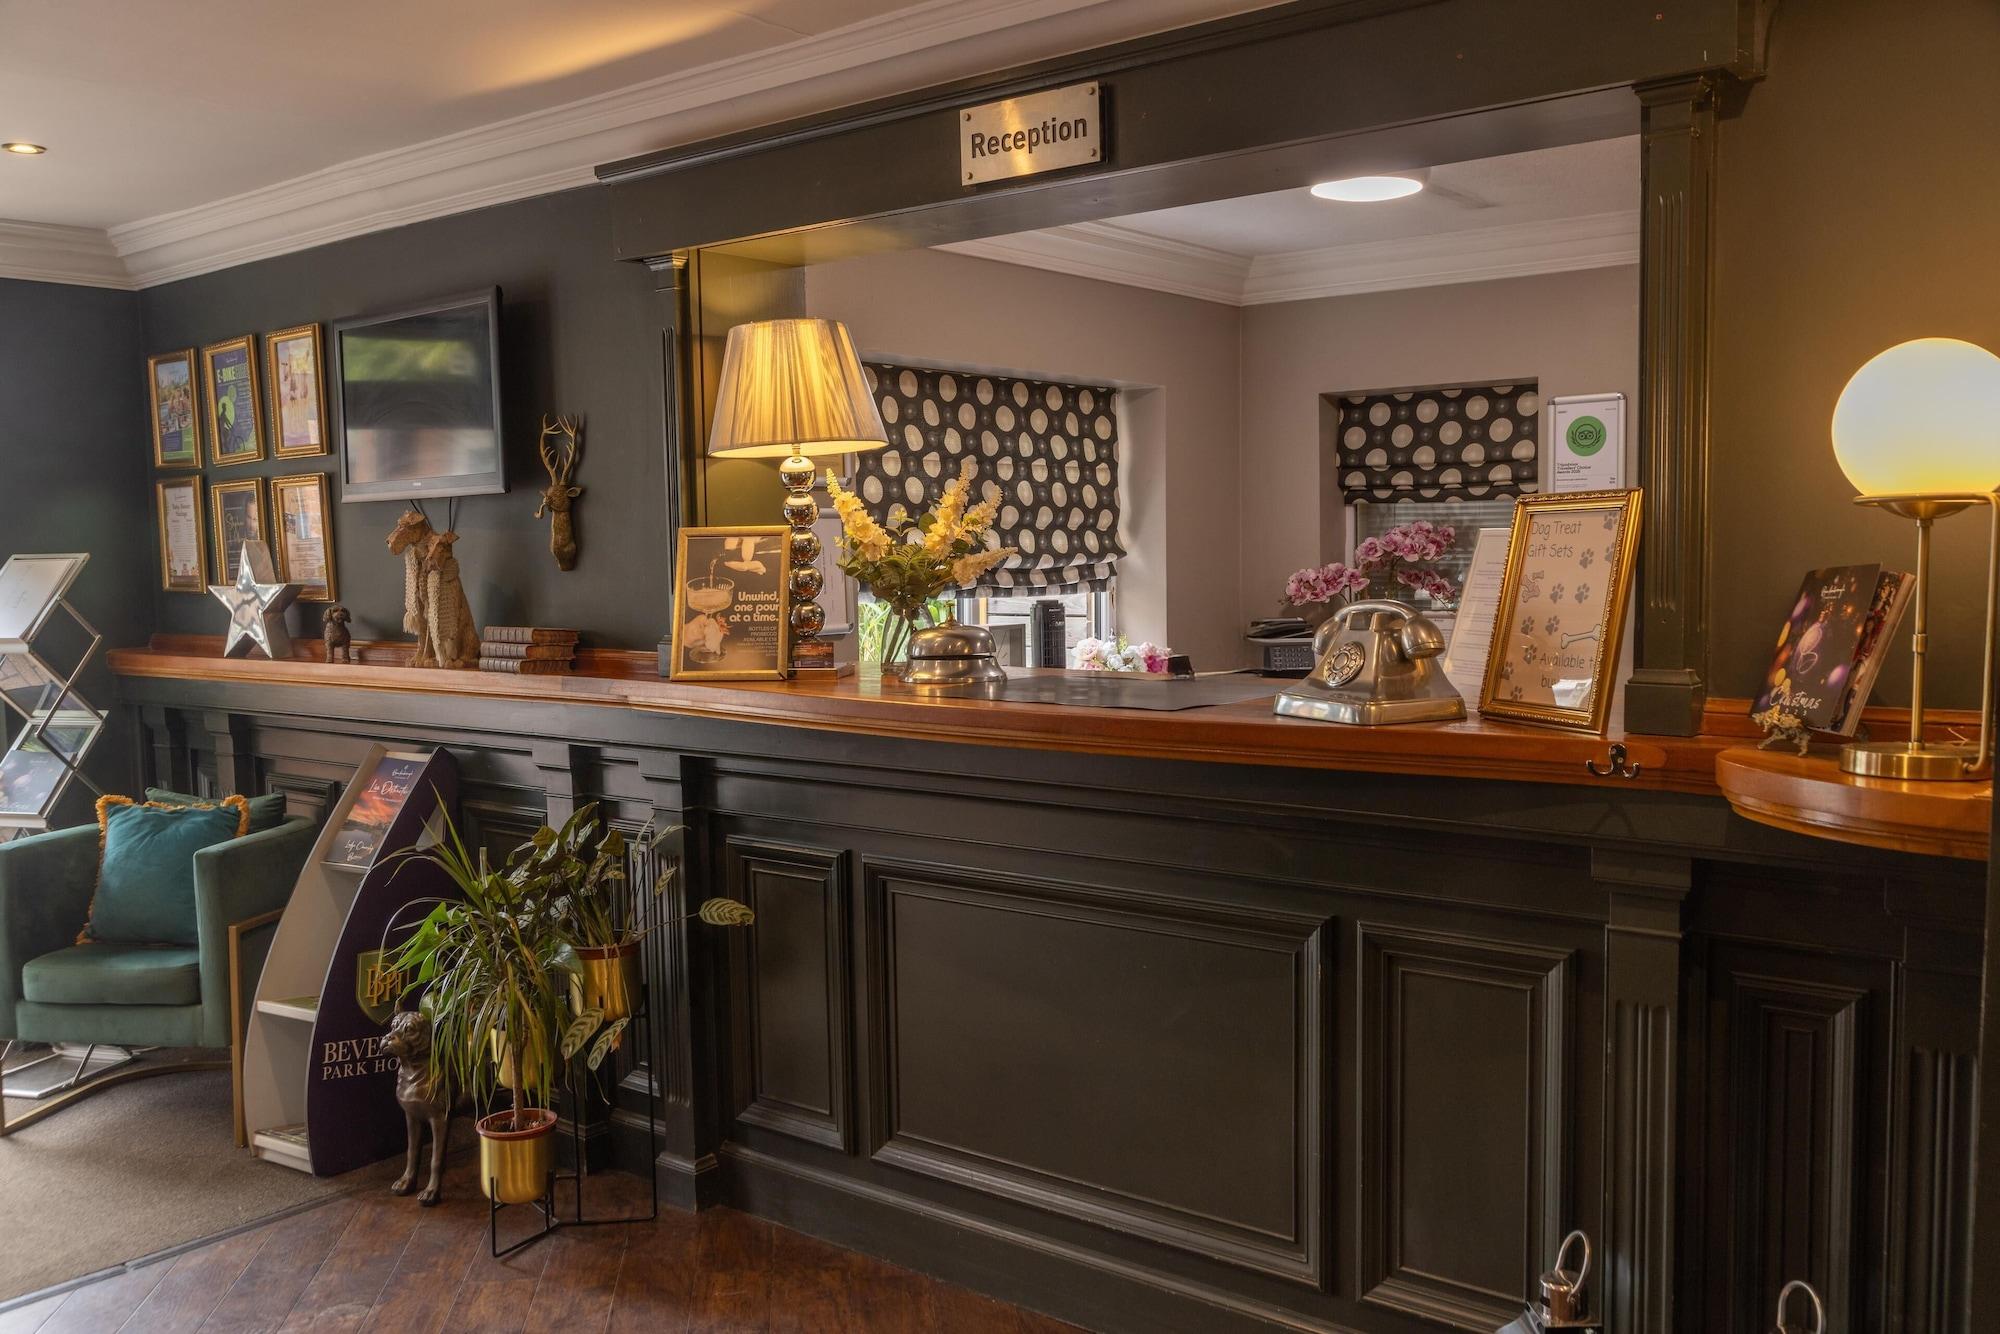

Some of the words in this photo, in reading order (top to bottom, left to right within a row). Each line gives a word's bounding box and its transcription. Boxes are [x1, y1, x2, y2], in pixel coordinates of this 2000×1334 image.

[971, 117, 1087, 159] Reception
[1531, 521, 1551, 541] Dog
[1553, 520, 1582, 535] Treat
[1527, 544, 1546, 558] Gift
[1549, 543, 1574, 558] Sets
[738, 591, 780, 603] Unwind,
[734, 604, 753, 612] one
[756, 603, 780, 615] pour
[729, 613, 741, 622] at
[743, 614, 751, 622] a
[753, 613, 779, 622] time.
[1539, 653, 1585, 669] Available
[322, 1036, 384, 1065] BEVE
[322, 1060, 368, 1081] PARK
